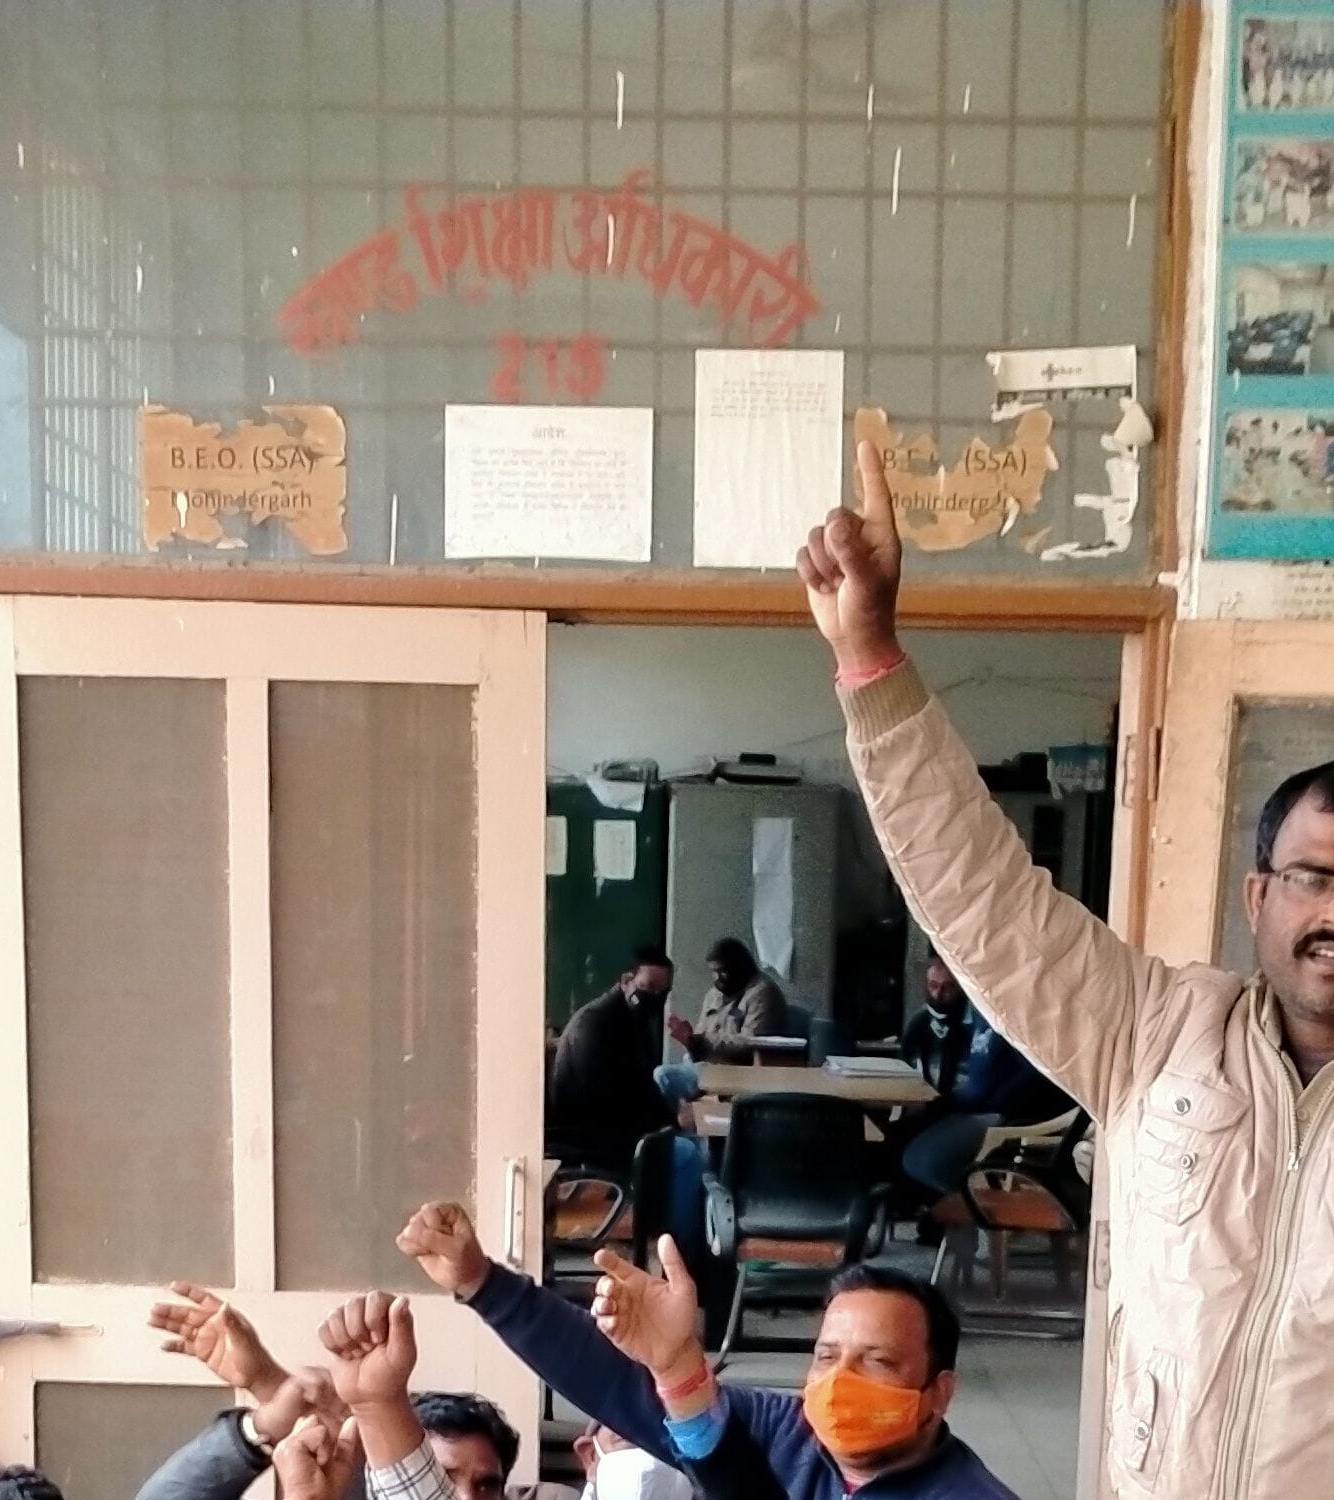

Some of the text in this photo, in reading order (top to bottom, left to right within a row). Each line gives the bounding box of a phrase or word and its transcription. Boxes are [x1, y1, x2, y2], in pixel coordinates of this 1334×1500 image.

[563, 167, 823, 349] अधिकारी
[170, 445, 316, 475] B.E.O. (SSA)
[964, 446, 1028, 477] (SSA)
